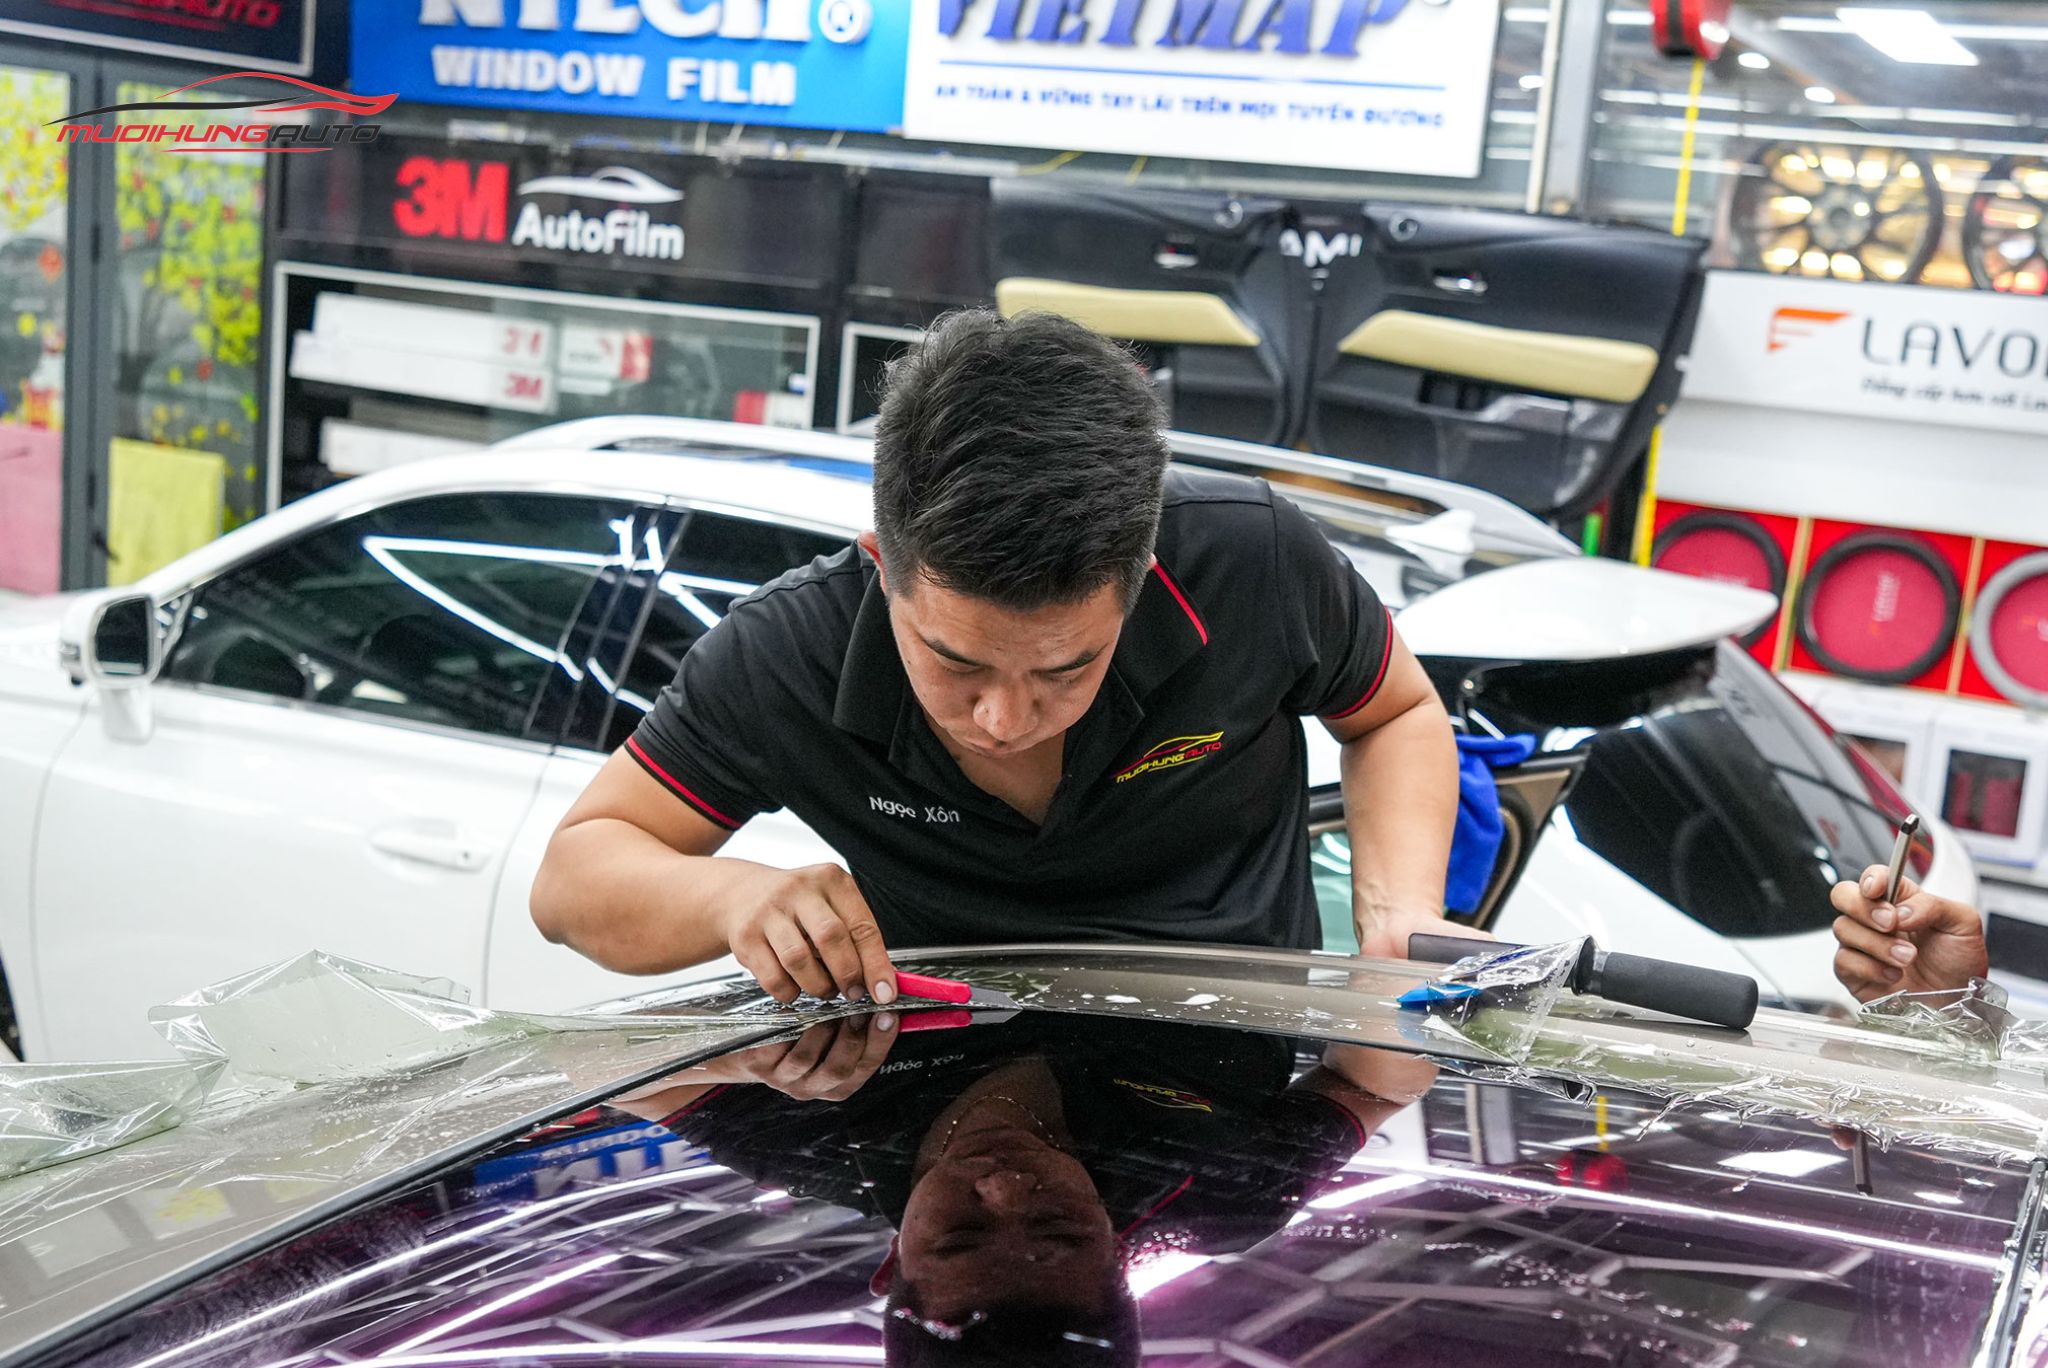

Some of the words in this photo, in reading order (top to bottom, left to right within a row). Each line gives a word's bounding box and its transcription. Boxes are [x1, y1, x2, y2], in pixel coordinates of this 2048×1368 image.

[431, 44, 645, 97] WINDOW
[667, 57, 797, 106] FILM
[393, 155, 510, 242] 3M
[511, 202, 686, 261] AutoFilm
[868, 796, 917, 818] Ngọc
[924, 806, 960, 823] Xôn
